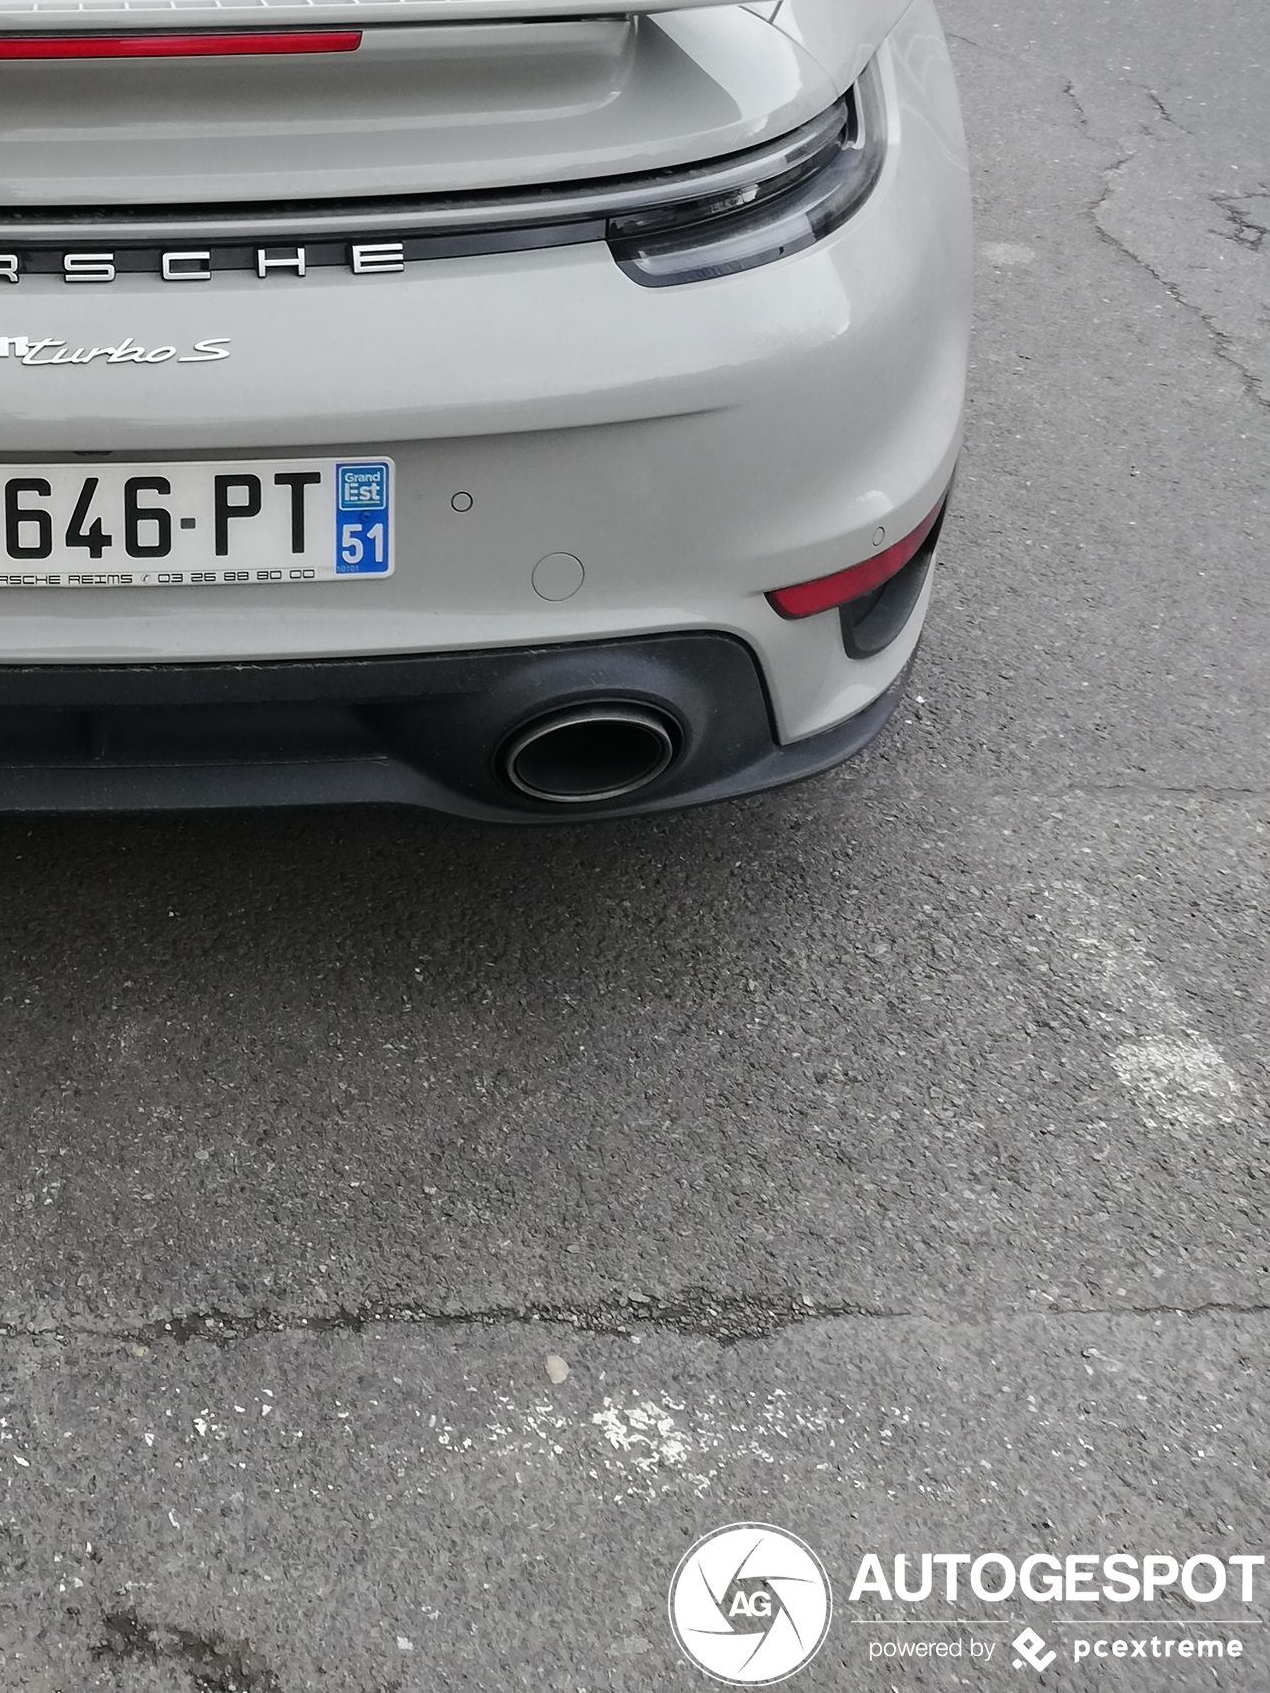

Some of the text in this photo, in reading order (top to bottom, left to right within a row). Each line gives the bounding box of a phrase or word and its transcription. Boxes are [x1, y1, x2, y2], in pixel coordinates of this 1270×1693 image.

[21, 337, 177, 365] turbo
[177, 337, 232, 363] S
[344, 471, 381, 483] Grand
[344, 482, 381, 501] Est
[341, 522, 385, 564] 51
[67, 573, 134, 584] REIMS
[157, 573, 184, 583] 03
[190, 572, 217, 583] 26
[223, 571, 250, 582] 88
[256, 570, 283, 580] 80
[289, 569, 315, 579] 00
